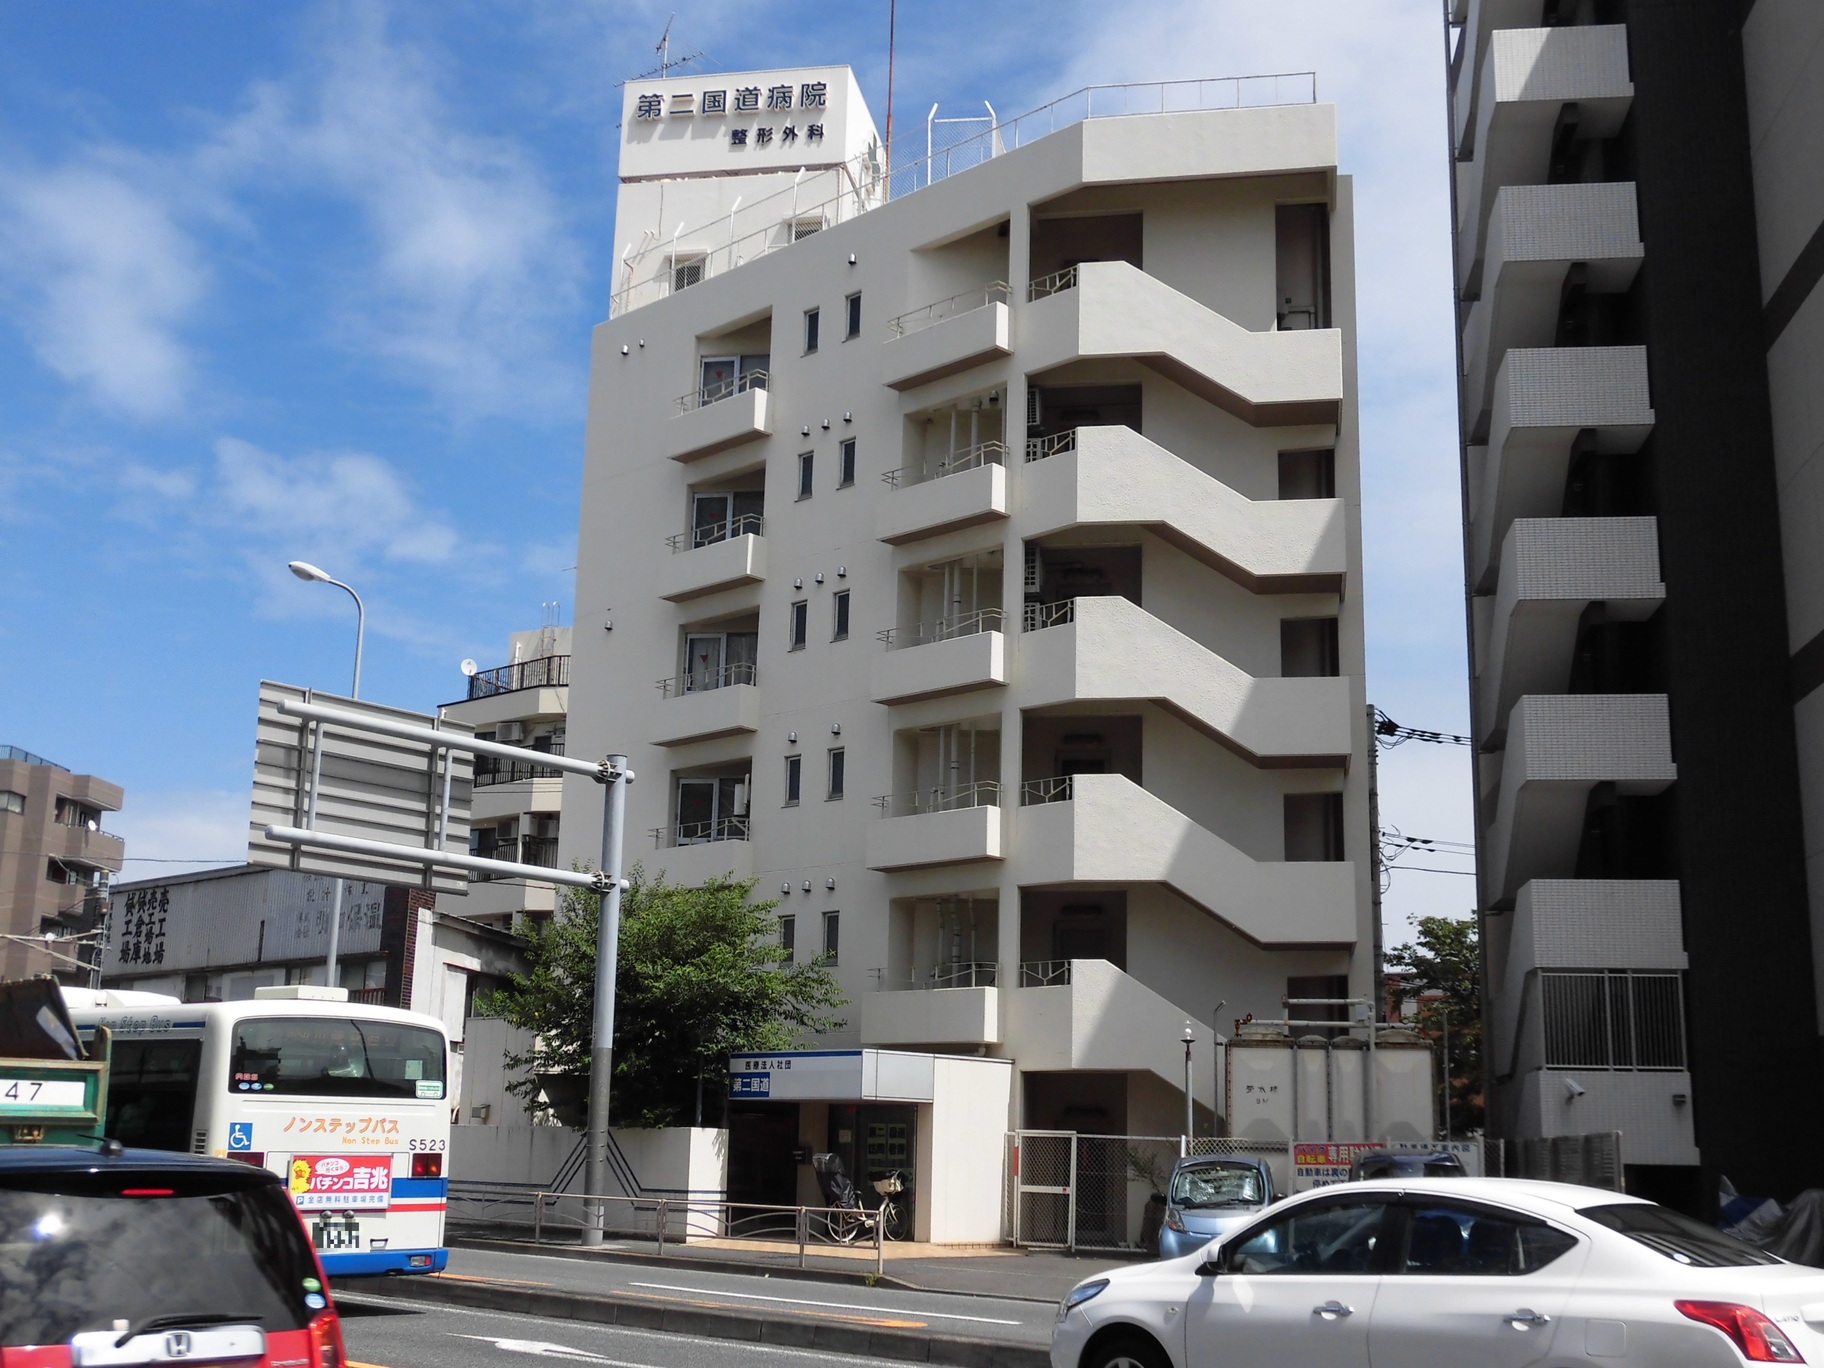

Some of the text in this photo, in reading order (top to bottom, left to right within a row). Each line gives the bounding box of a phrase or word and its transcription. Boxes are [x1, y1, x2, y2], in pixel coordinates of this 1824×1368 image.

[637, 81, 828, 119] 第二国道病院
[730, 123, 825, 145] 整形外科
[745, 1060, 791, 1070] 医療法人社団
[5, 1081, 43, 1101] 47
[733, 1077, 769, 1092] 第二国道
[283, 1116, 399, 1134] ノンステップバス
[342, 1137, 399, 1146] Non Step Bus
[409, 1139, 446, 1151] S523
[1297, 1155, 1326, 1164] 自転車
[310, 1167, 388, 1190] パチンコ吉兆
